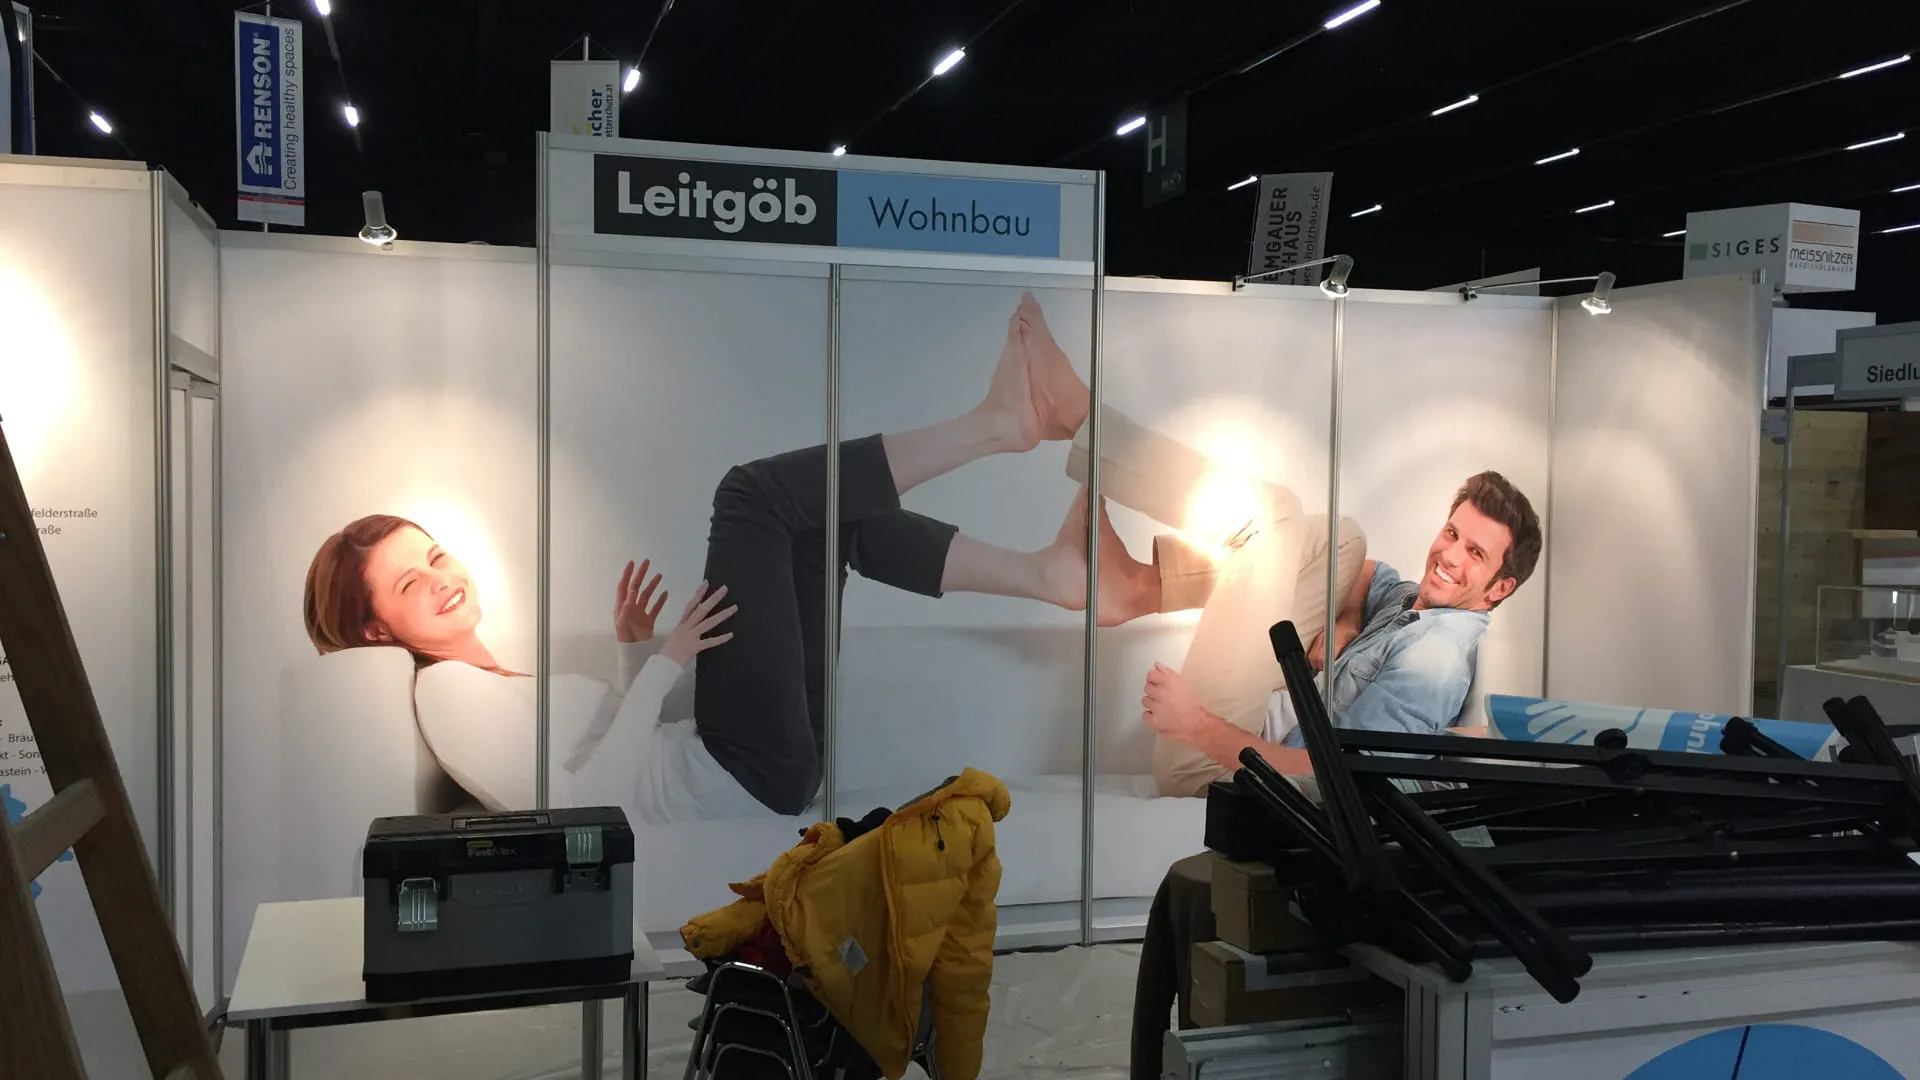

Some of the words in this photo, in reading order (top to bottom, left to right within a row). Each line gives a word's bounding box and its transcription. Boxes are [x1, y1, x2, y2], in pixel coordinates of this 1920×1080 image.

[284, 28, 298, 77] spaces
[253, 37, 273, 139] RENSON
[282, 79, 298, 129] healthy
[283, 129, 299, 190] Creating
[1147, 114, 1167, 173] H
[617, 170, 817, 233] Leitgöb
[868, 196, 1031, 237] Wohnbau
[1712, 237, 1780, 258] SIGES
